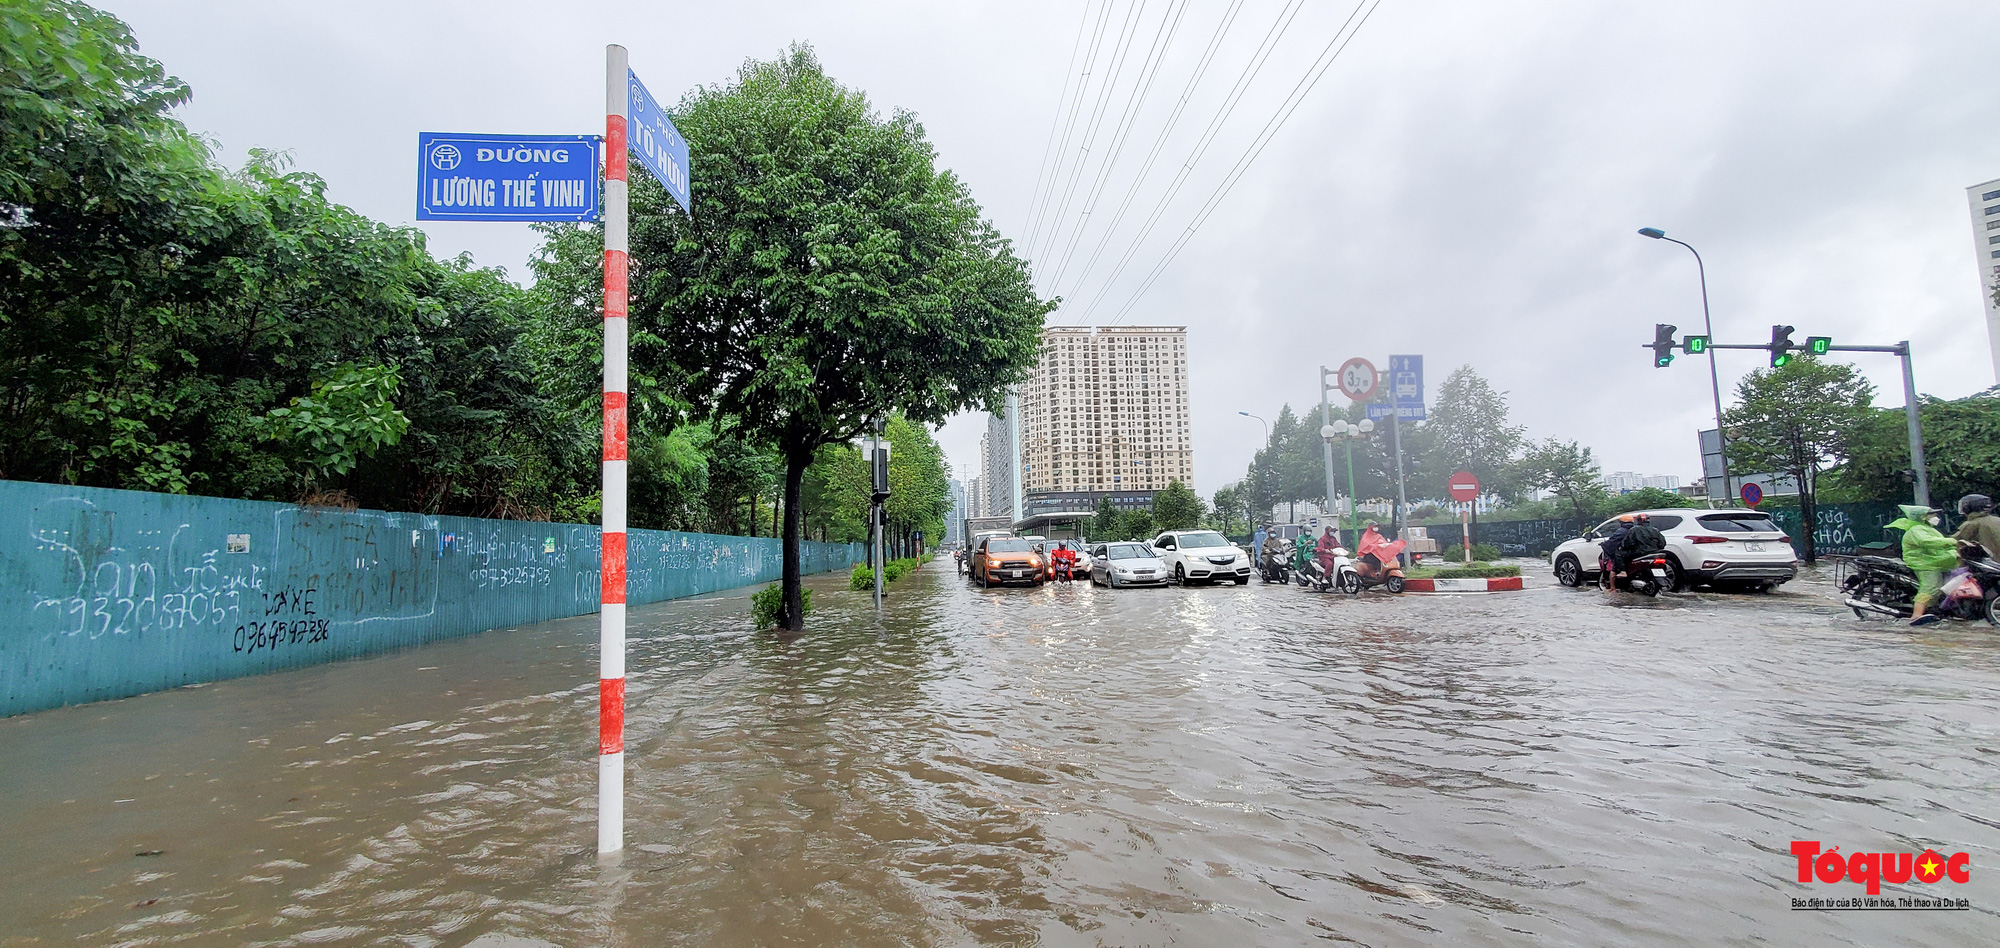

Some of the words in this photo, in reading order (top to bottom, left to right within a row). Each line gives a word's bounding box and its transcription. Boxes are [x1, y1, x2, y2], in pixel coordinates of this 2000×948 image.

[656, 116, 675, 147] PHỐ
[476, 144, 569, 163] ĐƯỜNG
[633, 115, 655, 159] TỐ
[657, 144, 685, 195] HỮU
[432, 175, 495, 207] LƯƠNG
[502, 172, 537, 207] THẾ
[542, 179, 585, 207] VINH
[1691, 339, 1702, 351] 10
[1814, 340, 1825, 352] 10
